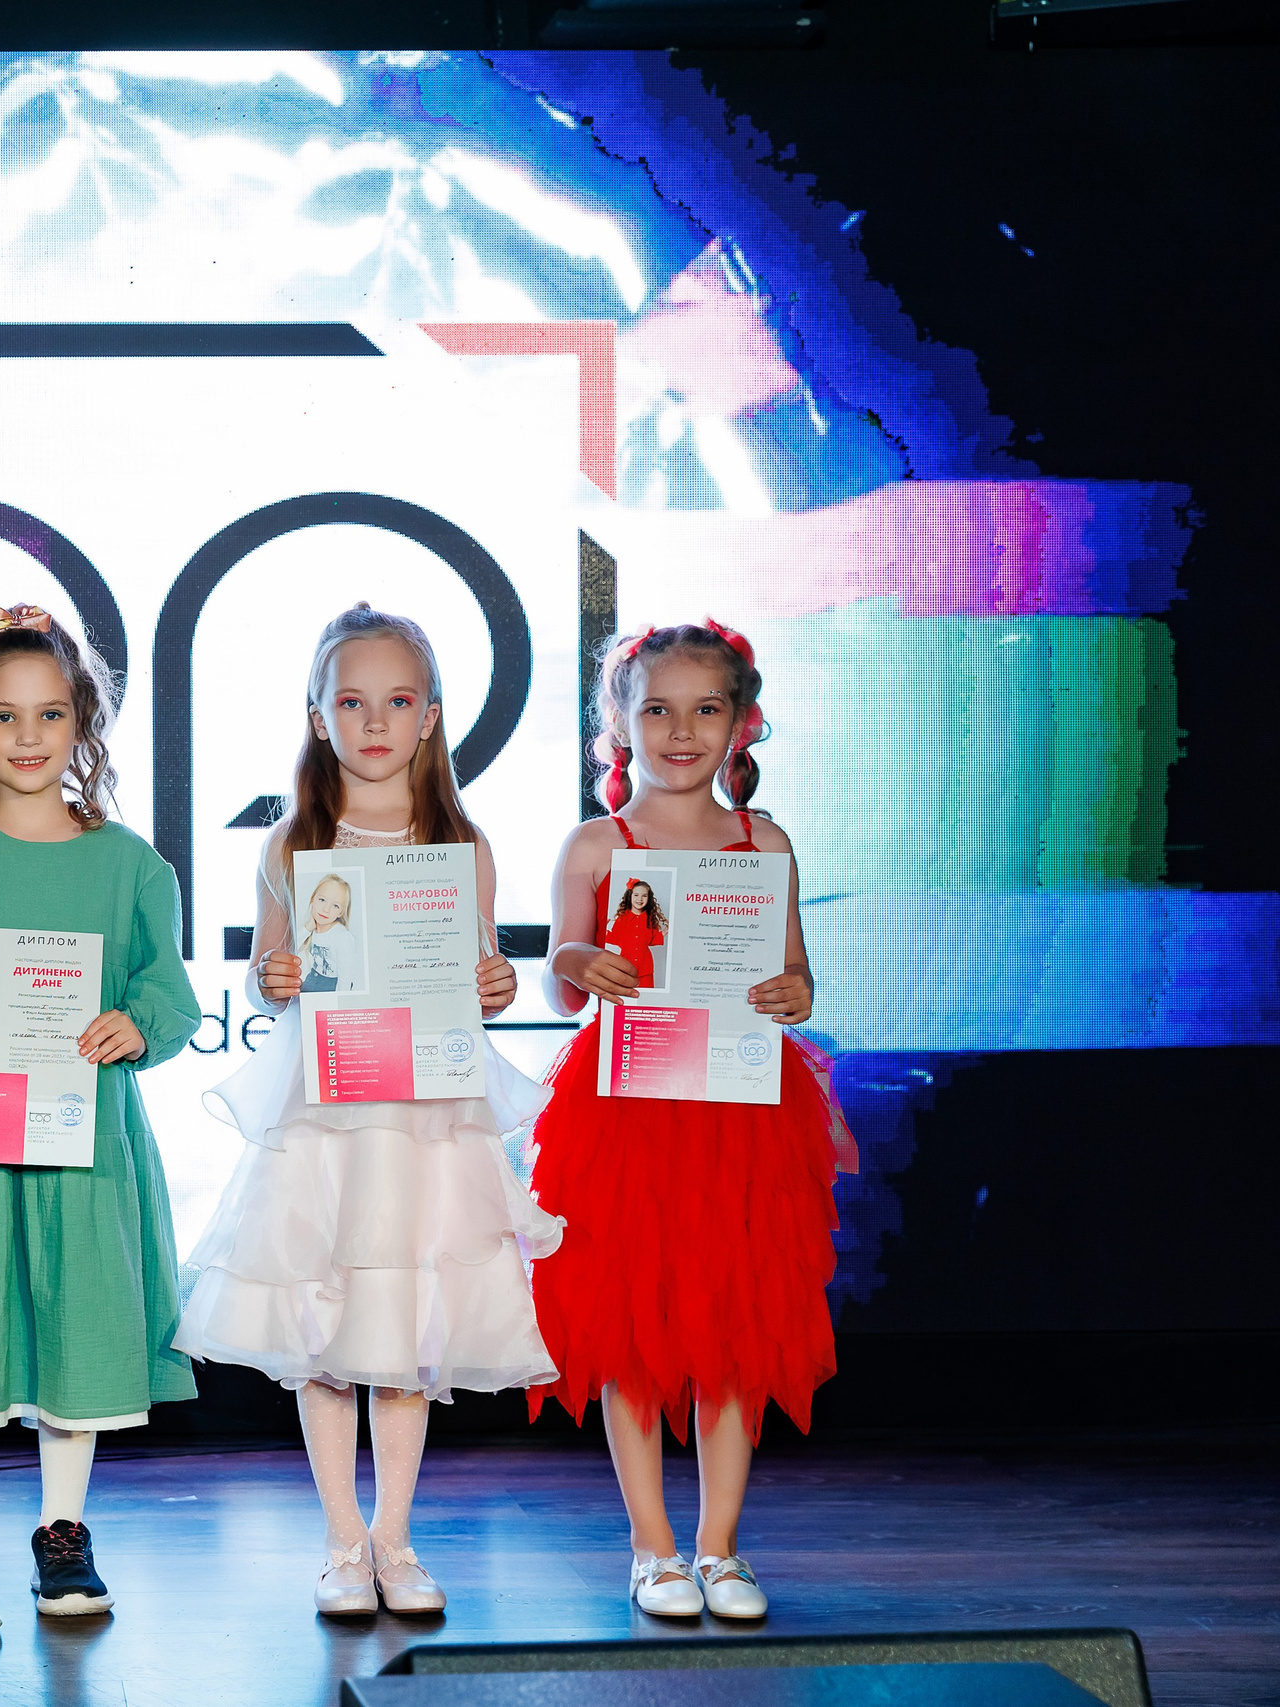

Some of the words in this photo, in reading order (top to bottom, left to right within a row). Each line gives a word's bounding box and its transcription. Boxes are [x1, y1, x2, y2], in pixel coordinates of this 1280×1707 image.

[386, 852, 447, 865] ДИПЛОМ
[699, 858, 759, 869] ДИПЛОМ
[388, 886, 458, 899] ЗАХАРОВОЙ
[686, 892, 774, 904] ИВАННИКОВОЙ
[393, 901, 455, 912] ВИКТОРИИ
[701, 906, 759, 916] АНГЕЛИНЕ
[18, 936, 77, 948] ДИПЛОМ
[13, 967, 82, 979] ДИТИНЕНКО
[32, 978, 62, 989] ДАНЕ
